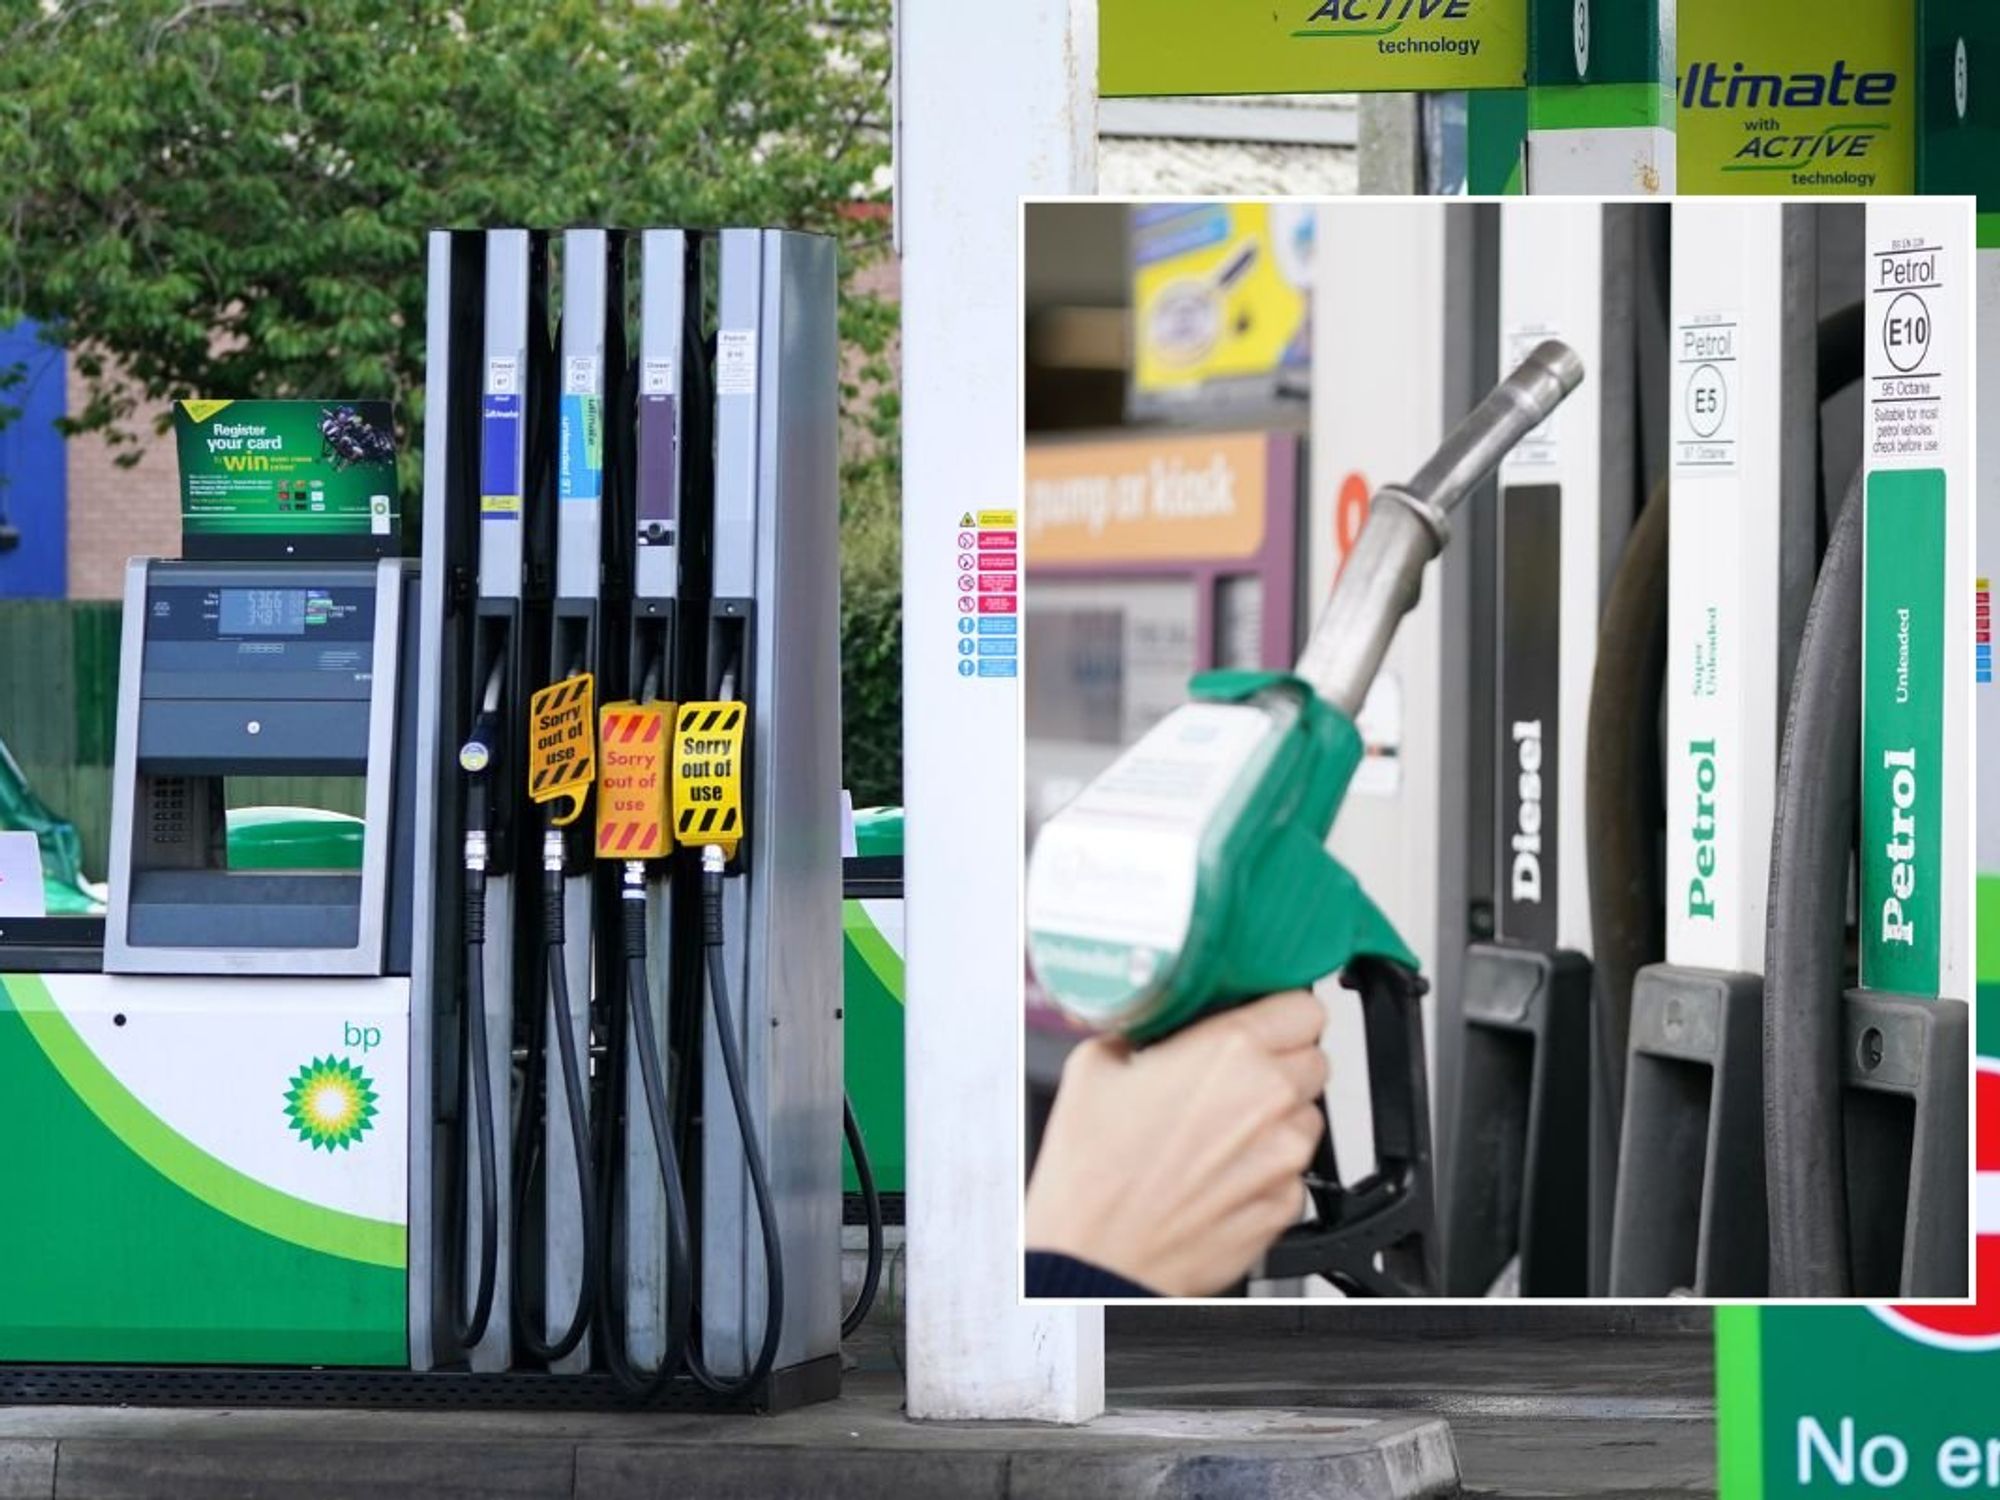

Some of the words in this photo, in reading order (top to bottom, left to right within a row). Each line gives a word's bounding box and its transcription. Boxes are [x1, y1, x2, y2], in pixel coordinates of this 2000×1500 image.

[1307, 0, 1472, 21] ACTIVE
[1378, 37, 1480, 55] technology
[1676, 61, 1897, 108] ltimate
[1744, 119, 1779, 132] with
[1736, 135, 1874, 158] ACTIVE
[1792, 172, 1876, 187] technology
[1881, 253, 1935, 286] Petrol
[1889, 316, 1927, 346] E10
[1684, 330, 1731, 356] Petrol
[1882, 382, 1894, 396] 95
[1896, 381, 1931, 395] Octane
[1695, 388, 1717, 413] E5
[1907, 406, 1917, 421] for
[213, 424, 267, 438] Register
[207, 438, 243, 453] your
[247, 435, 282, 450] card
[1923, 439, 1938, 452] use
[223, 450, 269, 472] win
[1896, 607, 1910, 704] Unleaded
[539, 704, 581, 730] Sorry
[537, 733, 563, 750] out
[568, 722, 583, 740] of
[684, 737, 732, 755] Sorry
[546, 746, 575, 766] use
[607, 752, 655, 770] Sorry
[682, 762, 711, 779] out
[714, 759, 732, 778] of
[604, 774, 633, 789] out
[639, 772, 656, 789] of
[690, 785, 723, 802] use
[615, 798, 645, 812] use
[1511, 719, 1542, 903] Diesel
[1688, 738, 1716, 920] Petrol
[1882, 747, 1916, 946] Petrol
[344, 1020, 381, 1053] bp
[1797, 1416, 1908, 1487] No
